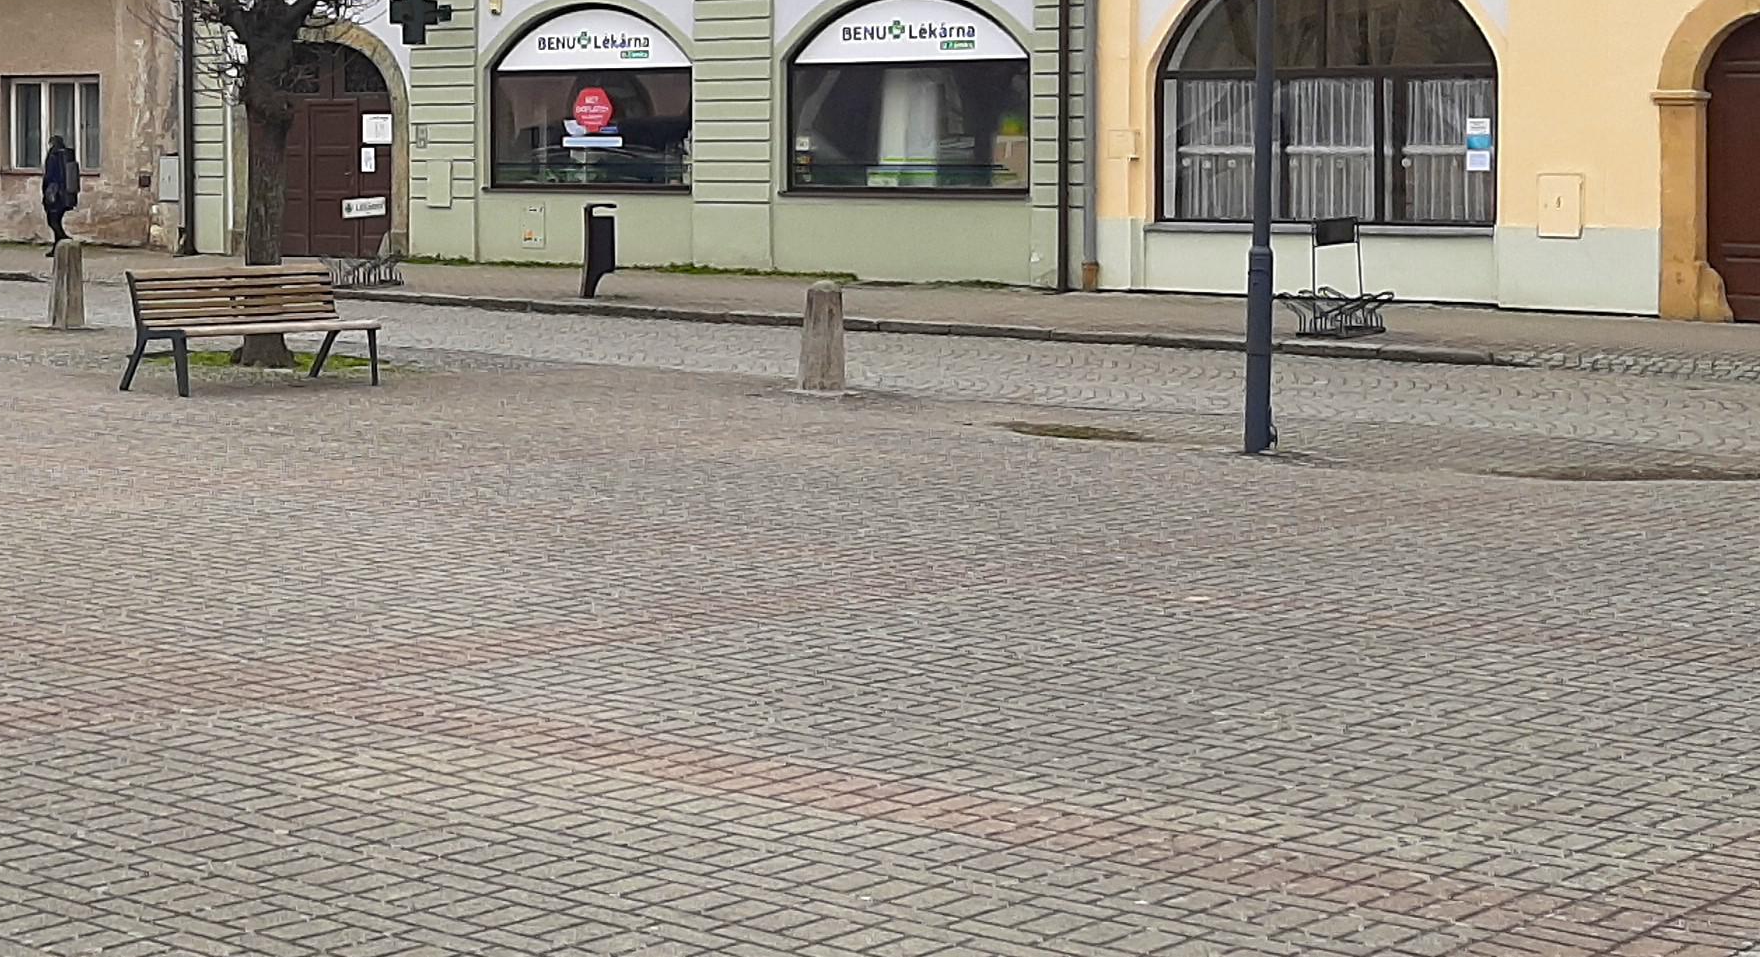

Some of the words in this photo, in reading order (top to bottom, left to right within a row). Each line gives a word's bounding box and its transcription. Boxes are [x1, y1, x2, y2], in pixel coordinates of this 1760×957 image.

[842, 25, 887, 41] BENU
[908, 23, 976, 39] Lékárna
[538, 36, 576, 50] BENU
[594, 33, 649, 49] Lékárna
